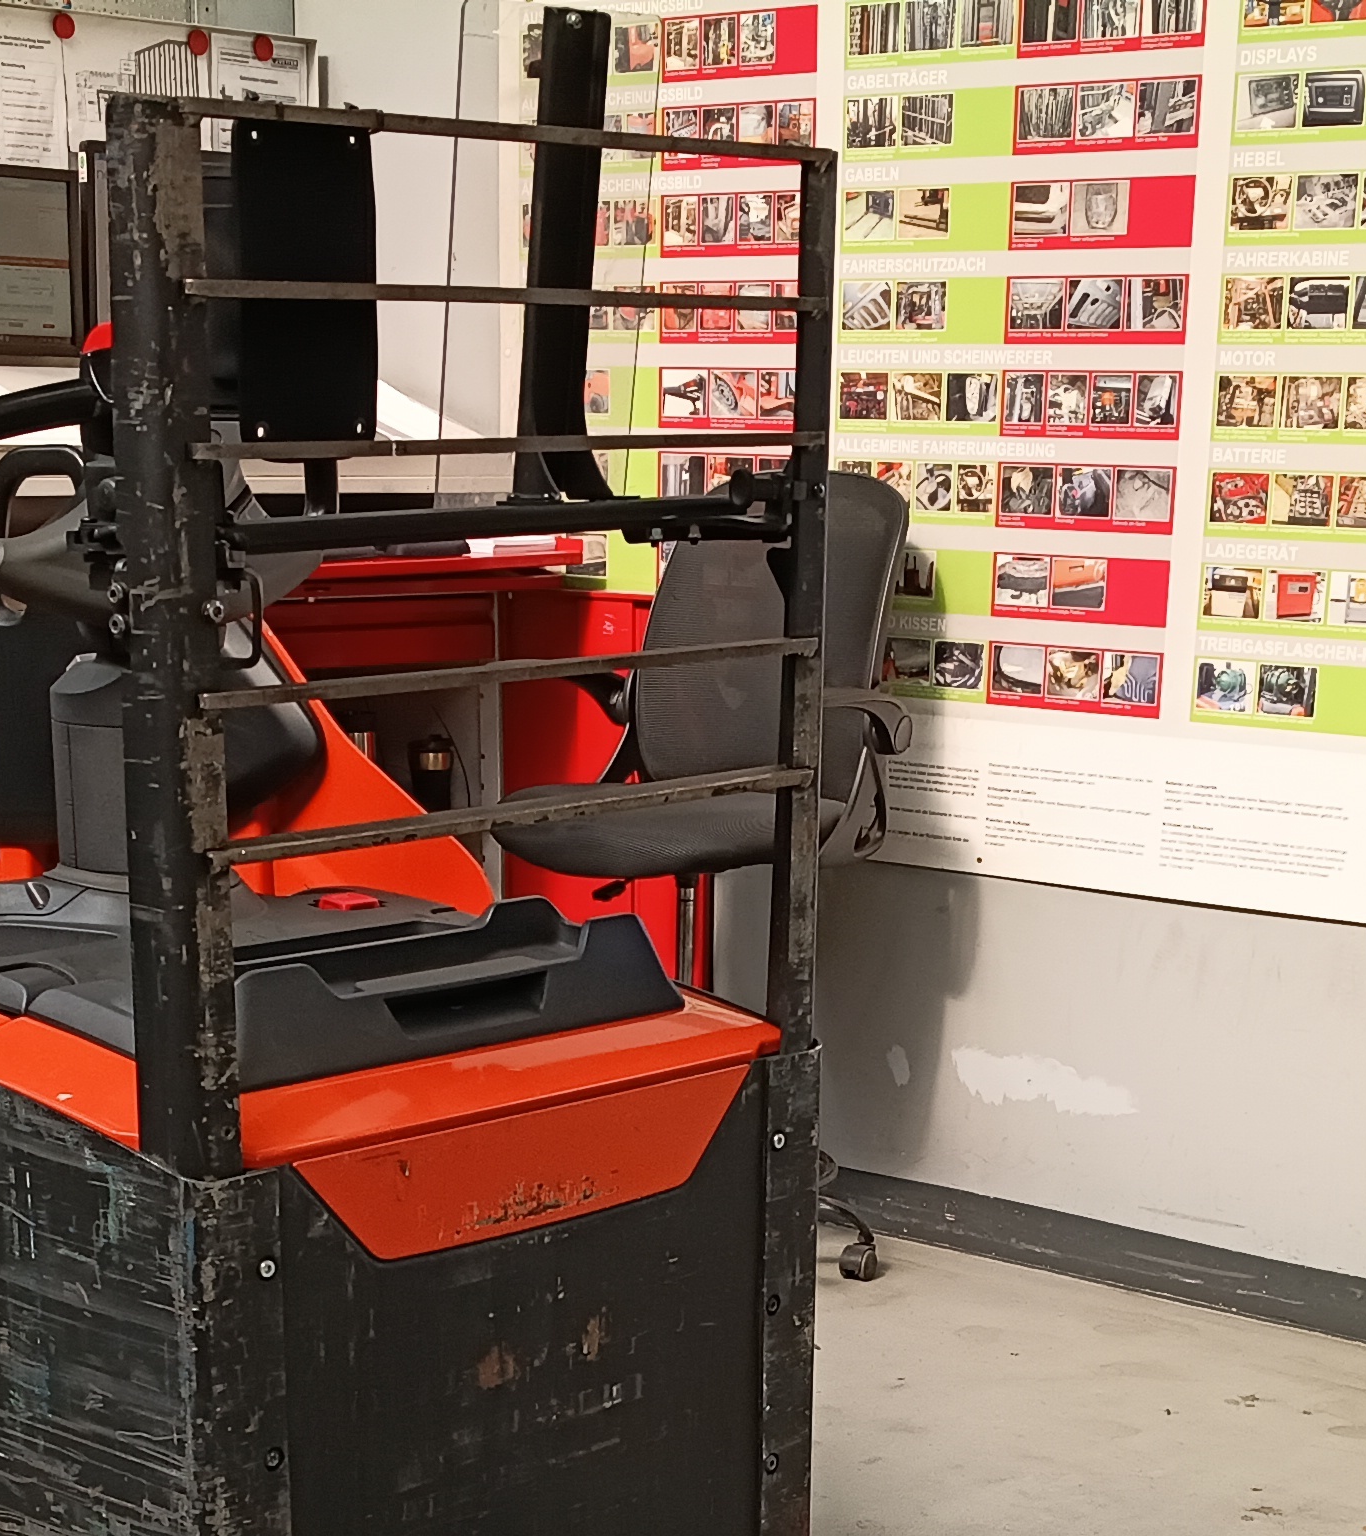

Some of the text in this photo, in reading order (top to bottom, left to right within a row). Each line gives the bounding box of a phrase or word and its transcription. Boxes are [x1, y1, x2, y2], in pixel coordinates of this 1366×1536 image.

[1240, 45, 1318, 66] DISPLAYS
[847, 69, 948, 90] GABELTRÄGER
[1233, 151, 1286, 167] HEBEL
[845, 166, 899, 182] GABELN
[842, 257, 986, 273] FAHRERSCHUTZDACH
[1226, 250, 1350, 267] FAHRERKABINE
[840, 349, 1053, 365] LEUCHTEN UND SCHEINWERFER
[1219, 350, 1276, 366] MOTOR
[837, 438, 1056, 458] ALLGEMEINE FAHRERUMGEBUNG
[1212, 447, 1287, 464] BATTERIE
[1205, 542, 1299, 561] LADEGERÄT
[899, 615, 946, 632] KISSEN
